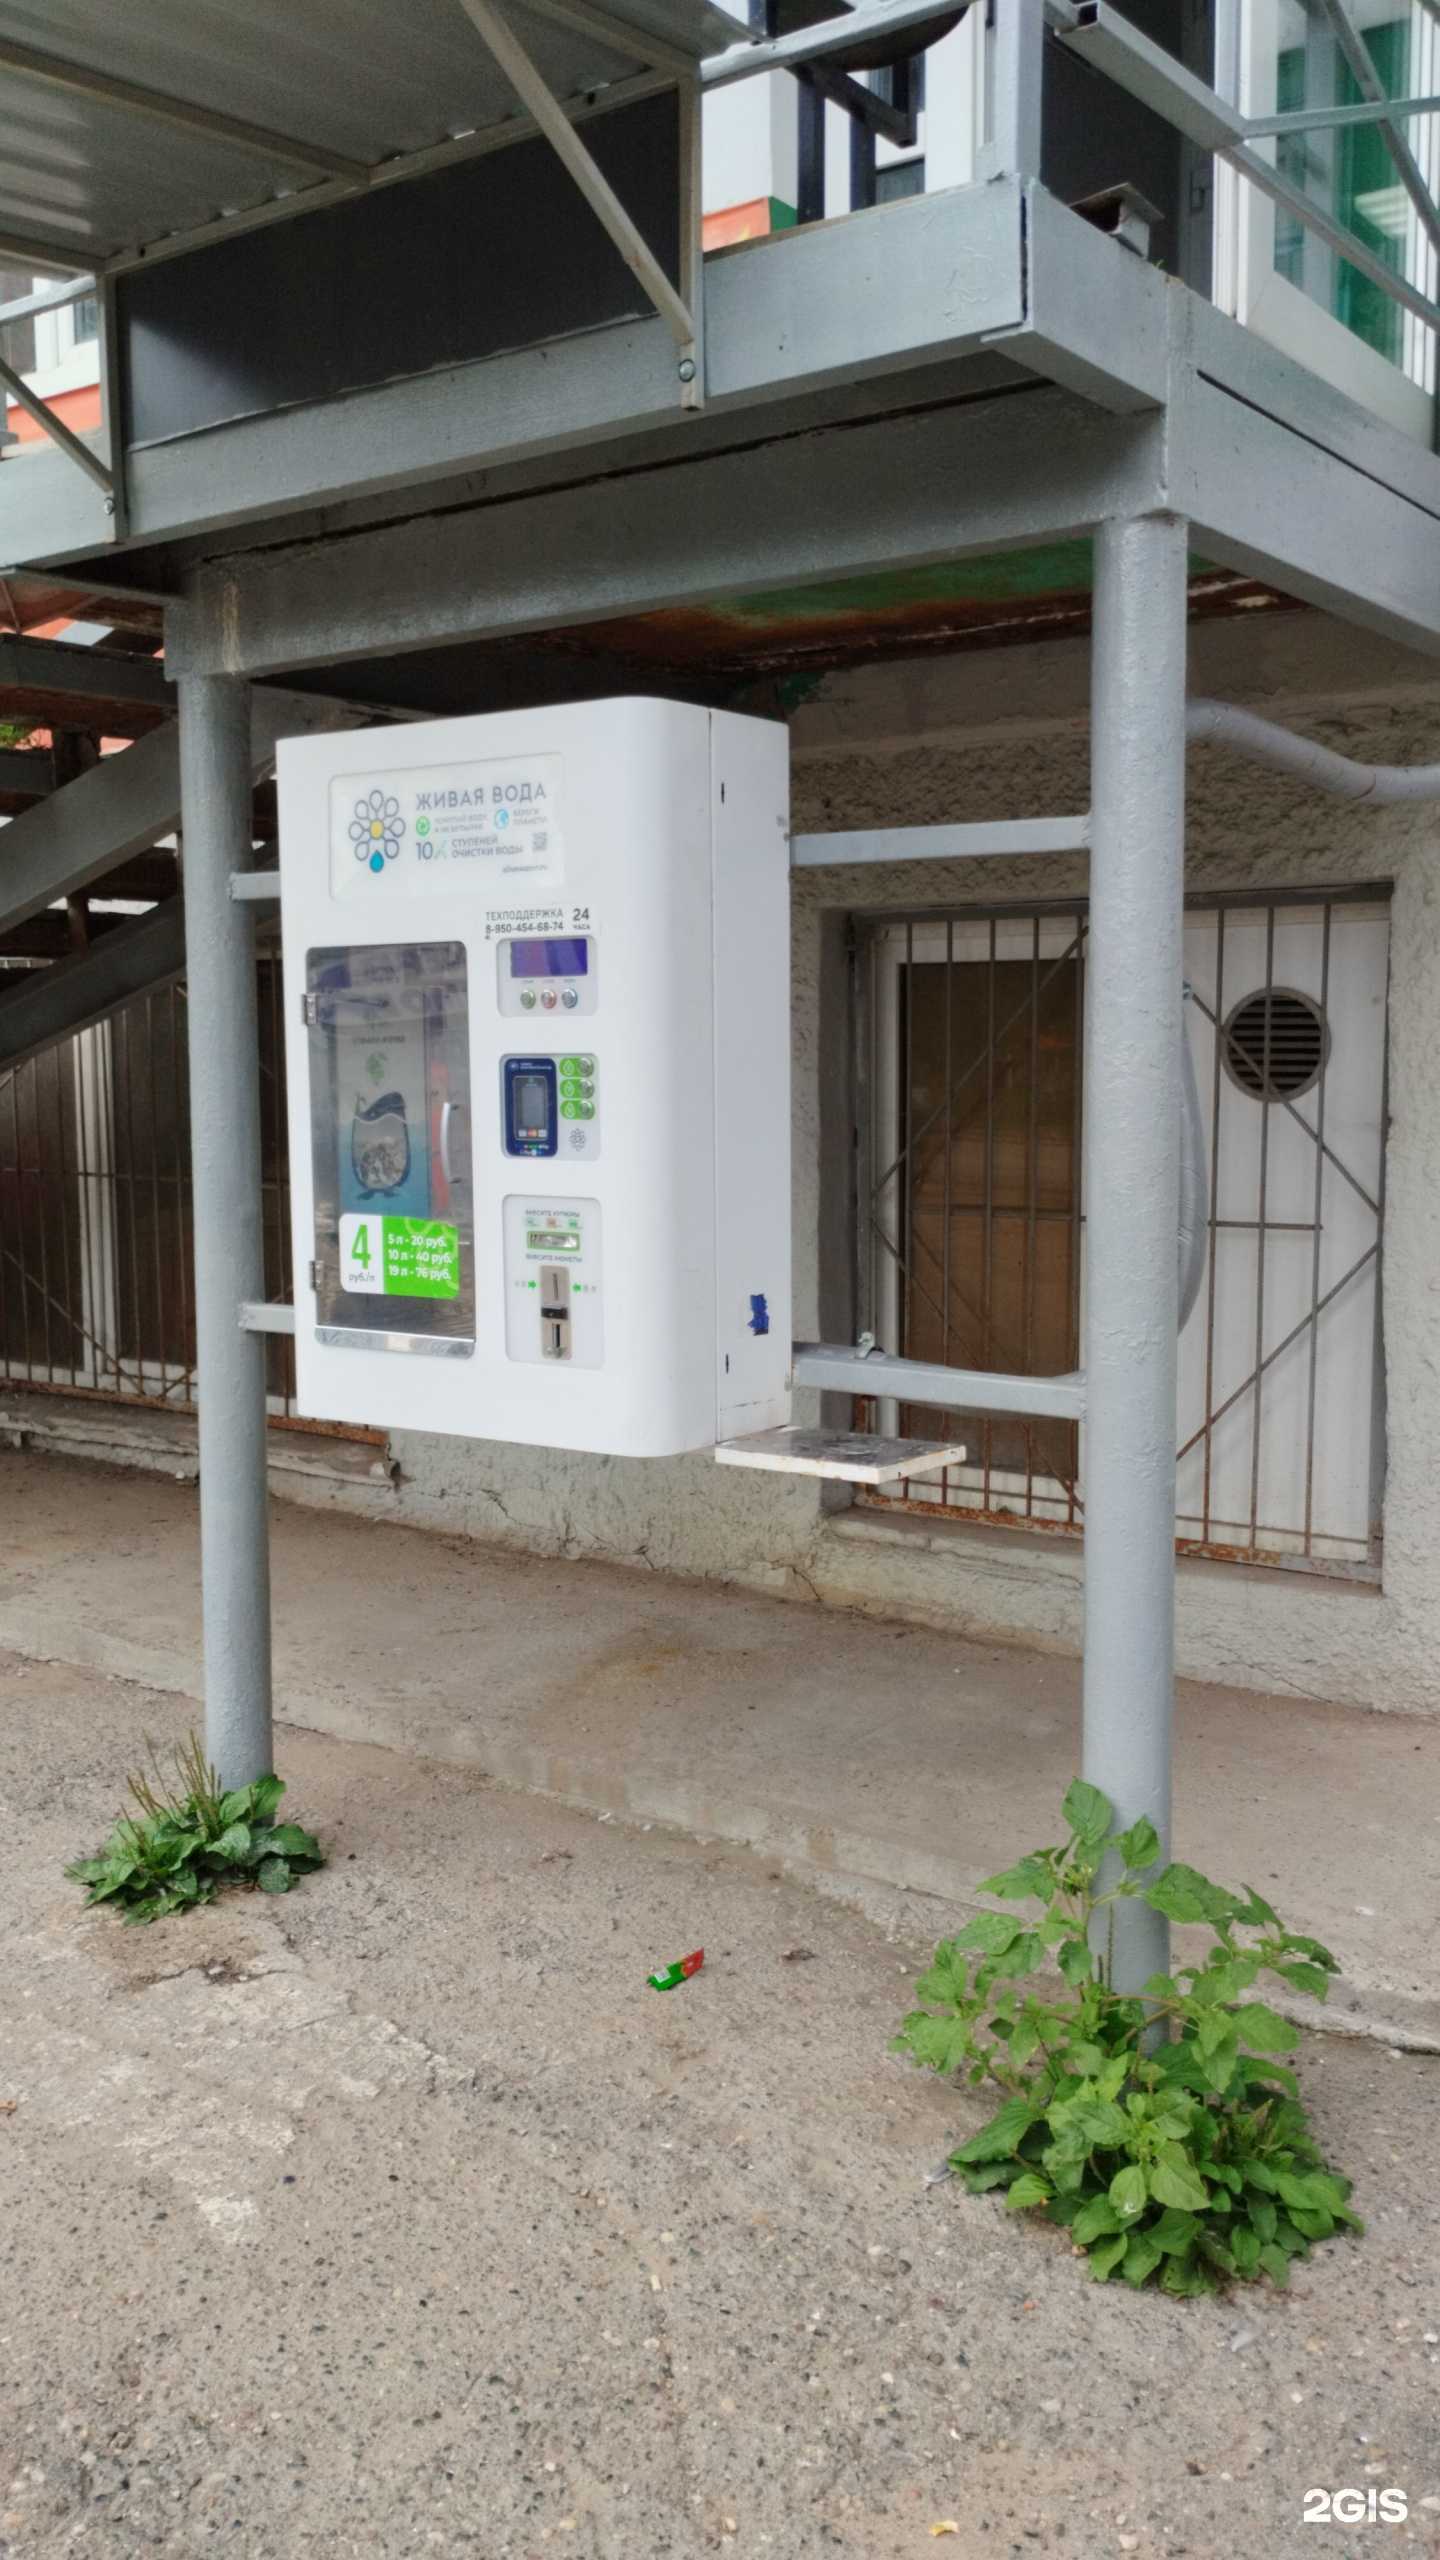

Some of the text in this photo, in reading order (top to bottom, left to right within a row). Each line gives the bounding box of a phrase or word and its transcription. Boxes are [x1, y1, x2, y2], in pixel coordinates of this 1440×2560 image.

[416, 783, 547, 811] ЖИВАЯ ВОДА
[451, 834, 498, 848] СТУПЕНЕЙ
[416, 841, 433, 860] 10
[451, 845, 524, 859] ОЧИСТКИ ВОДЫ
[485, 908, 564, 921] ТЕХПОДДЕРЖКА
[573, 907, 589, 921] 24
[352, 1224, 371, 1270] 4
[388, 1233, 395, 1245] 5
[411, 1235, 423, 1246] 20
[426, 1236, 447, 1249] руб.
[388, 1249, 399, 1260] 10
[416, 1251, 430, 1262] 40
[431, 1253, 452, 1265] руб.
